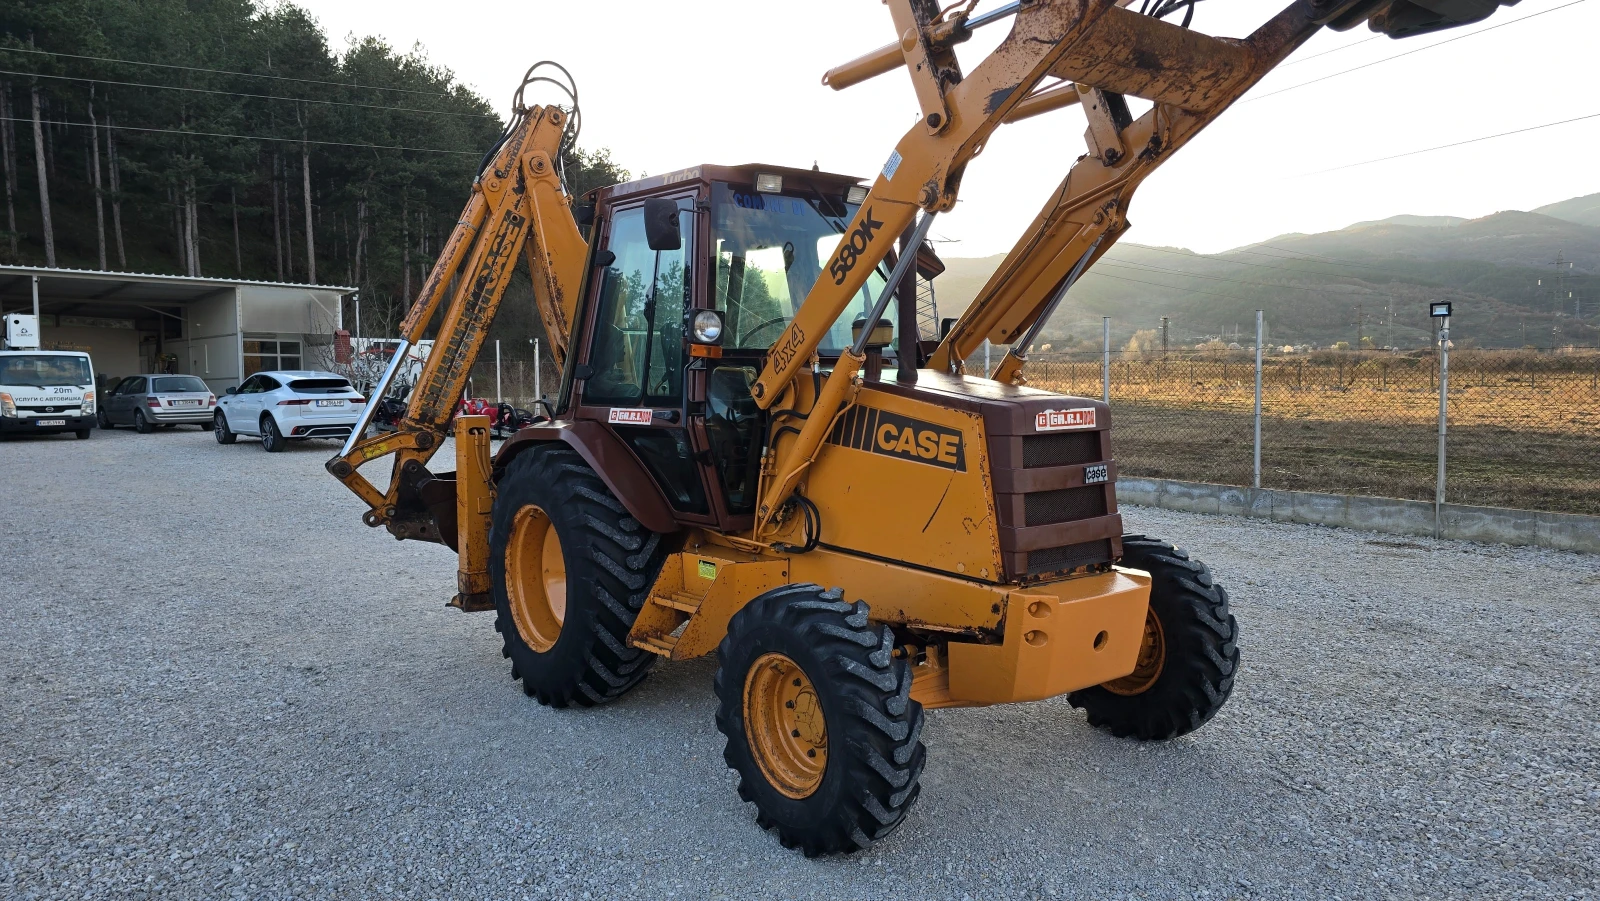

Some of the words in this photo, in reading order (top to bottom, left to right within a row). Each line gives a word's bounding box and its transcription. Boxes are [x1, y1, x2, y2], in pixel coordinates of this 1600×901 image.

[481, 221, 520, 290] CASE
[830, 205, 884, 285] 580K
[773, 323, 805, 375] 4x4
[877, 423, 959, 464] CASE
[1086, 468, 1106, 480] case
